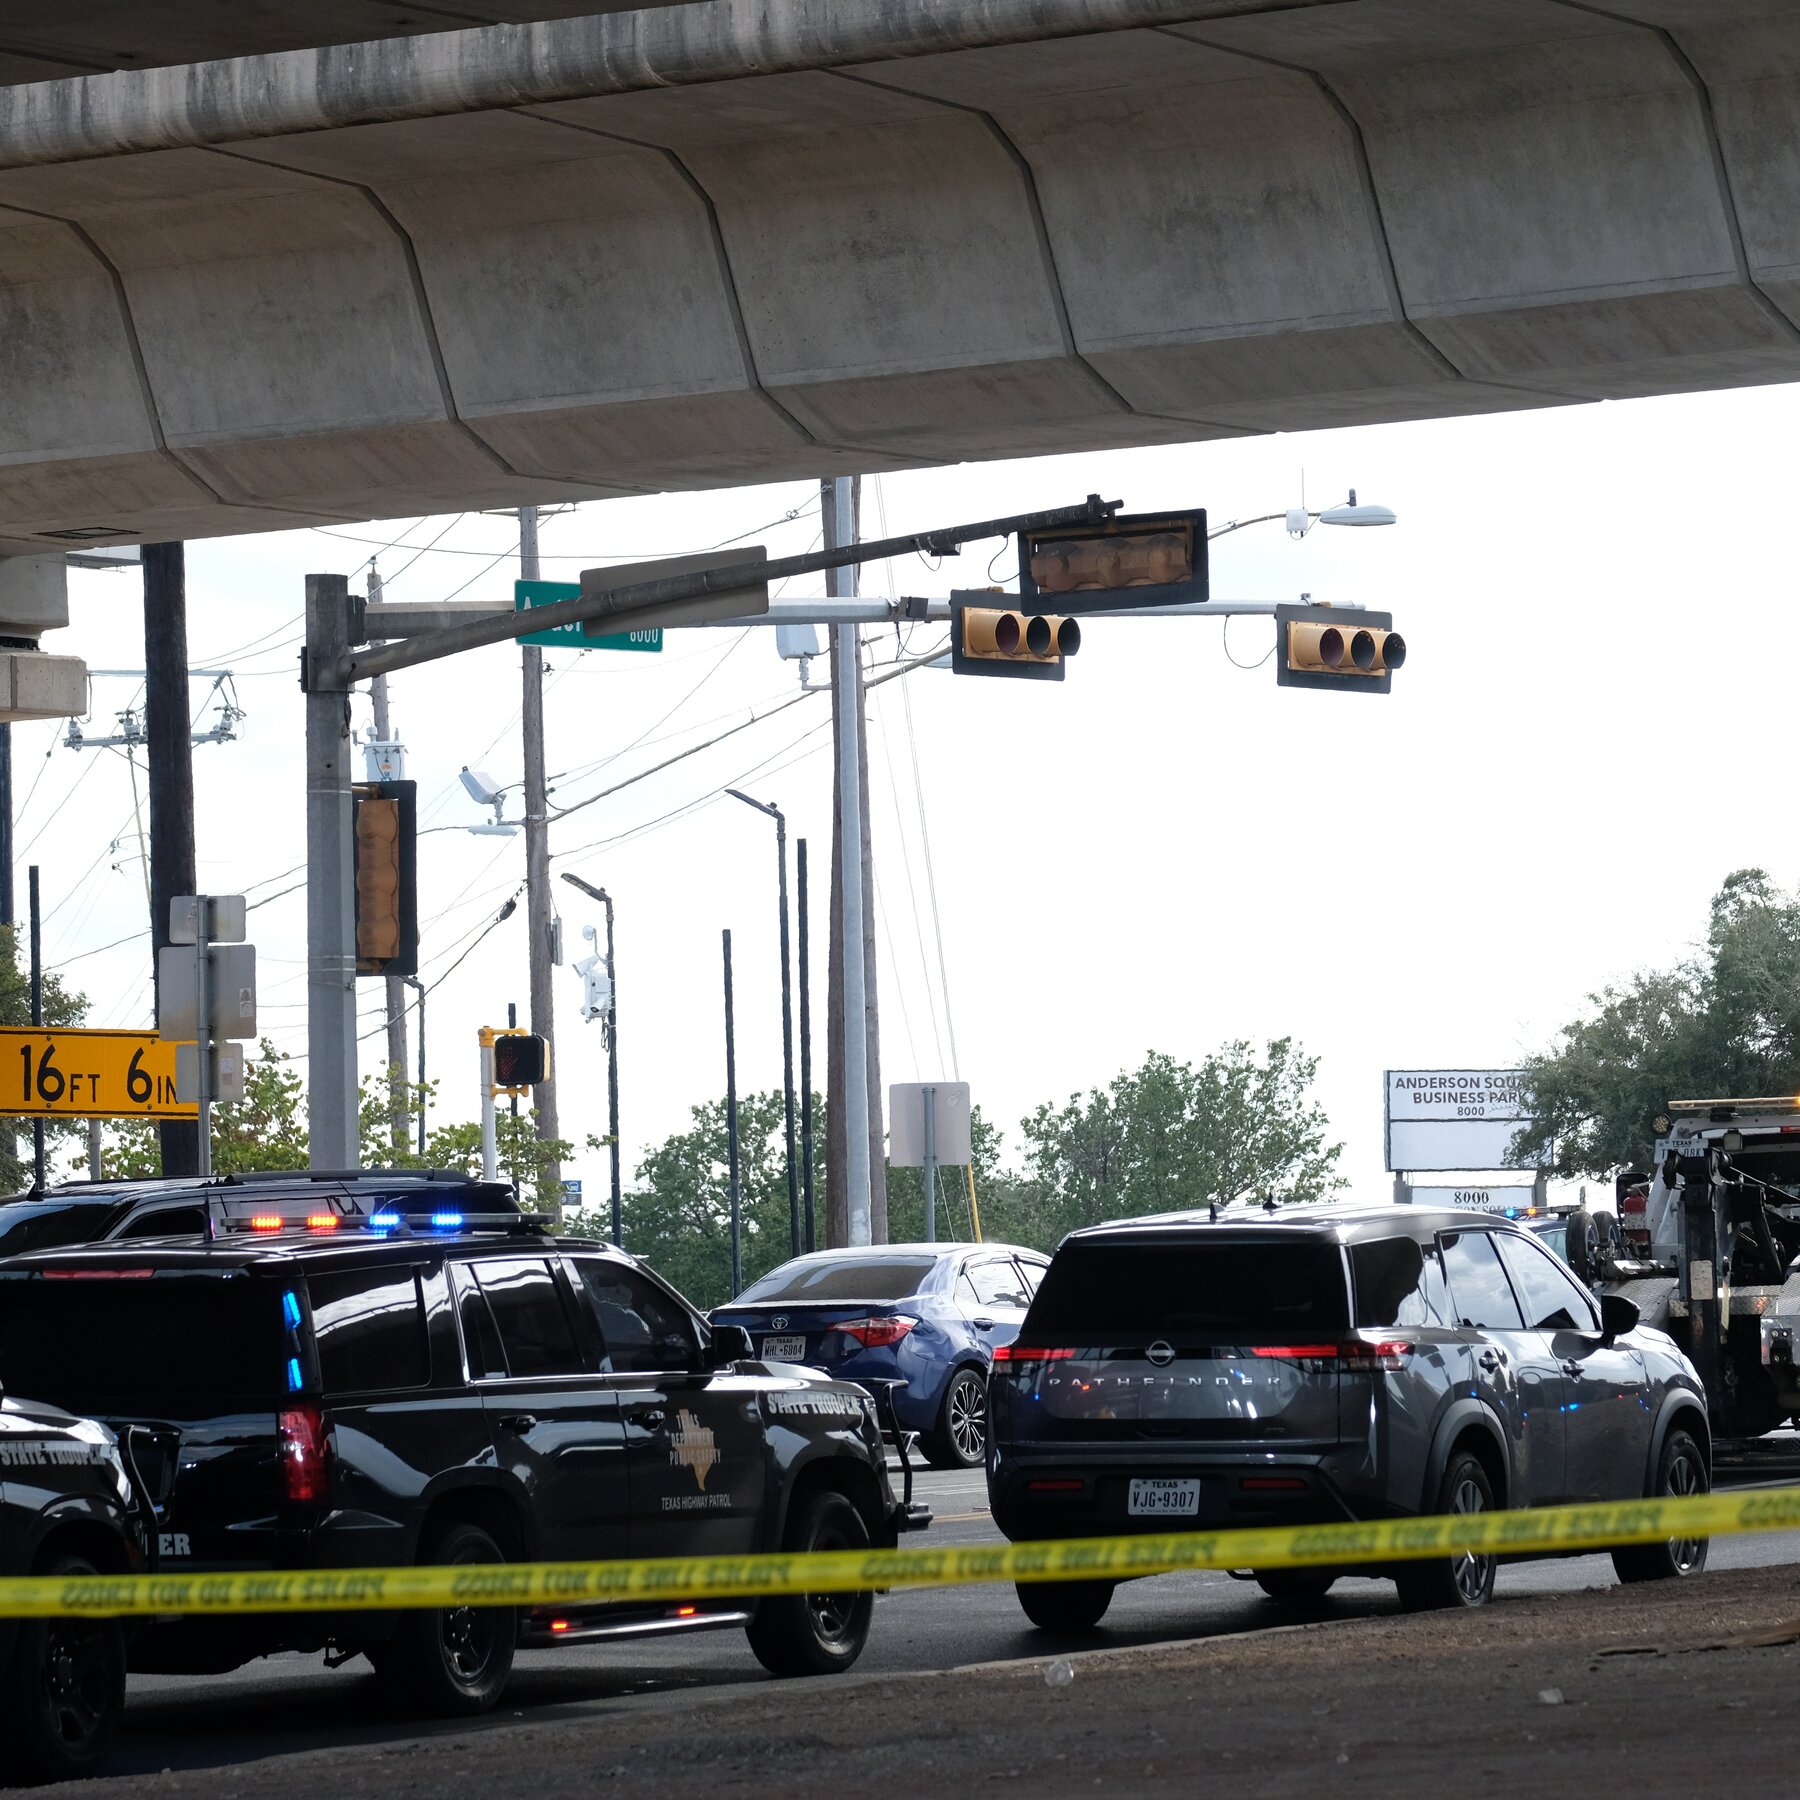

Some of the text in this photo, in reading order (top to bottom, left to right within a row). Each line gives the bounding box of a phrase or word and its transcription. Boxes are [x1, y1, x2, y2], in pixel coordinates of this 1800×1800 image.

[20, 1044, 66, 1103] 16
[69, 1073, 101, 1103] FT
[126, 1047, 153, 1103] 6
[1395, 1077, 1481, 1089] ANDERSON
[1413, 1092, 1485, 1104] BUSINESS
[1457, 1106, 1485, 1116] 8000
[1454, 1191, 1489, 1204] 8000
[1049, 1376, 1281, 1387] PATHFINDER
[767, 1392, 810, 1414] STATE
[0, 1442, 46, 1466] STATE
[662, 1494, 732, 1511] TEXAS HIGHWAY PATROL
